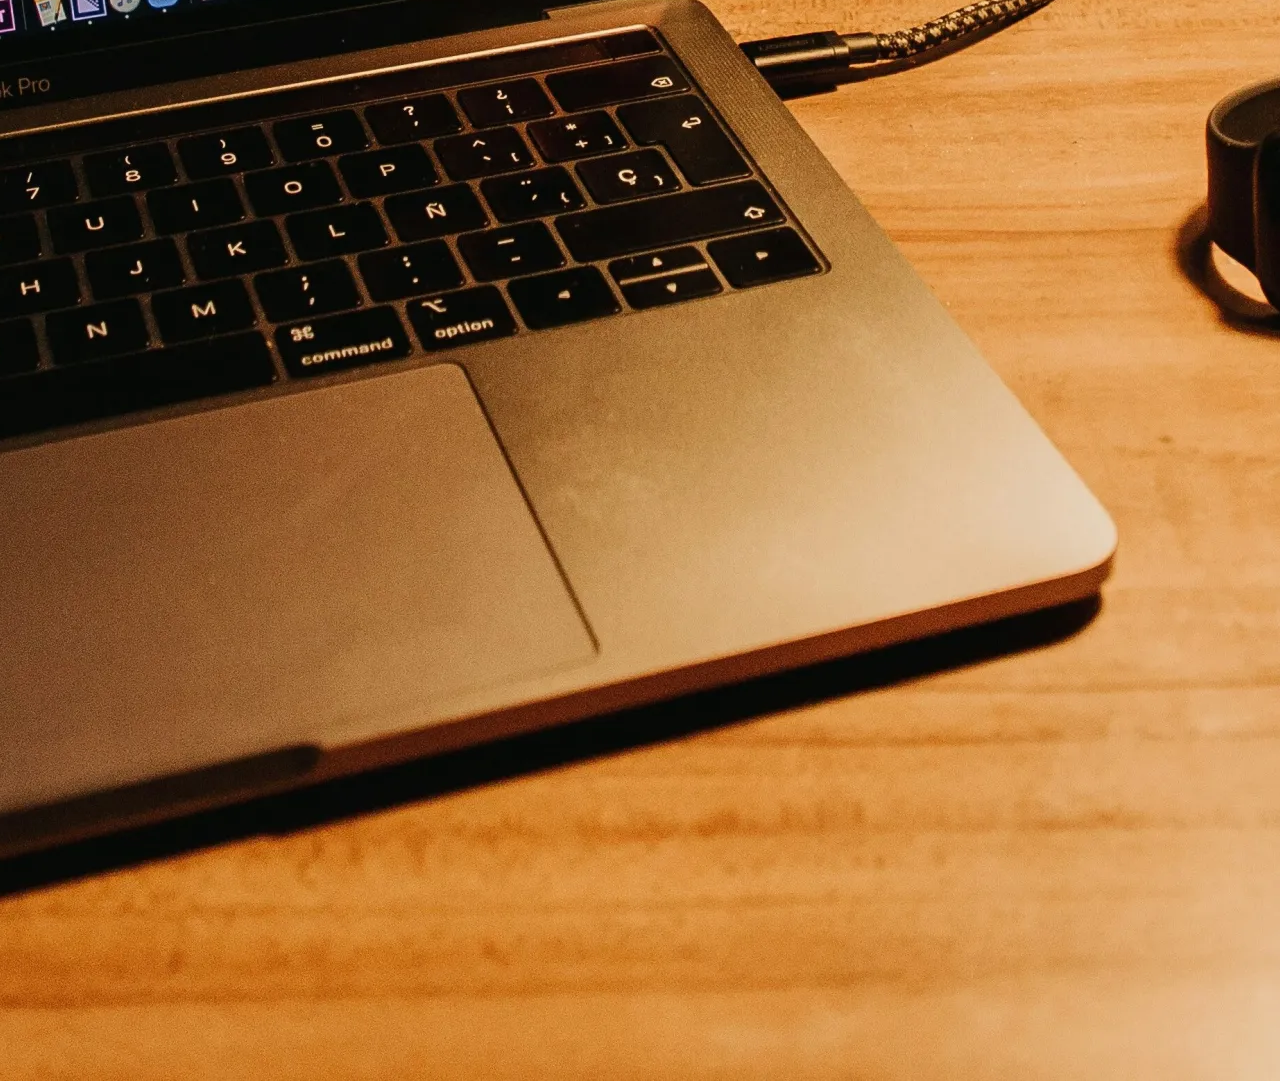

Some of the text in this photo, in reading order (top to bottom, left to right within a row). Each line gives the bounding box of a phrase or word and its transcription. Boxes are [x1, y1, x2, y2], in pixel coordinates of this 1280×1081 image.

[18, 76, 51, 96] Pro
[425, 202, 447, 219] Ñ
[434, 319, 494, 341] option
[301, 337, 393, 366] command
